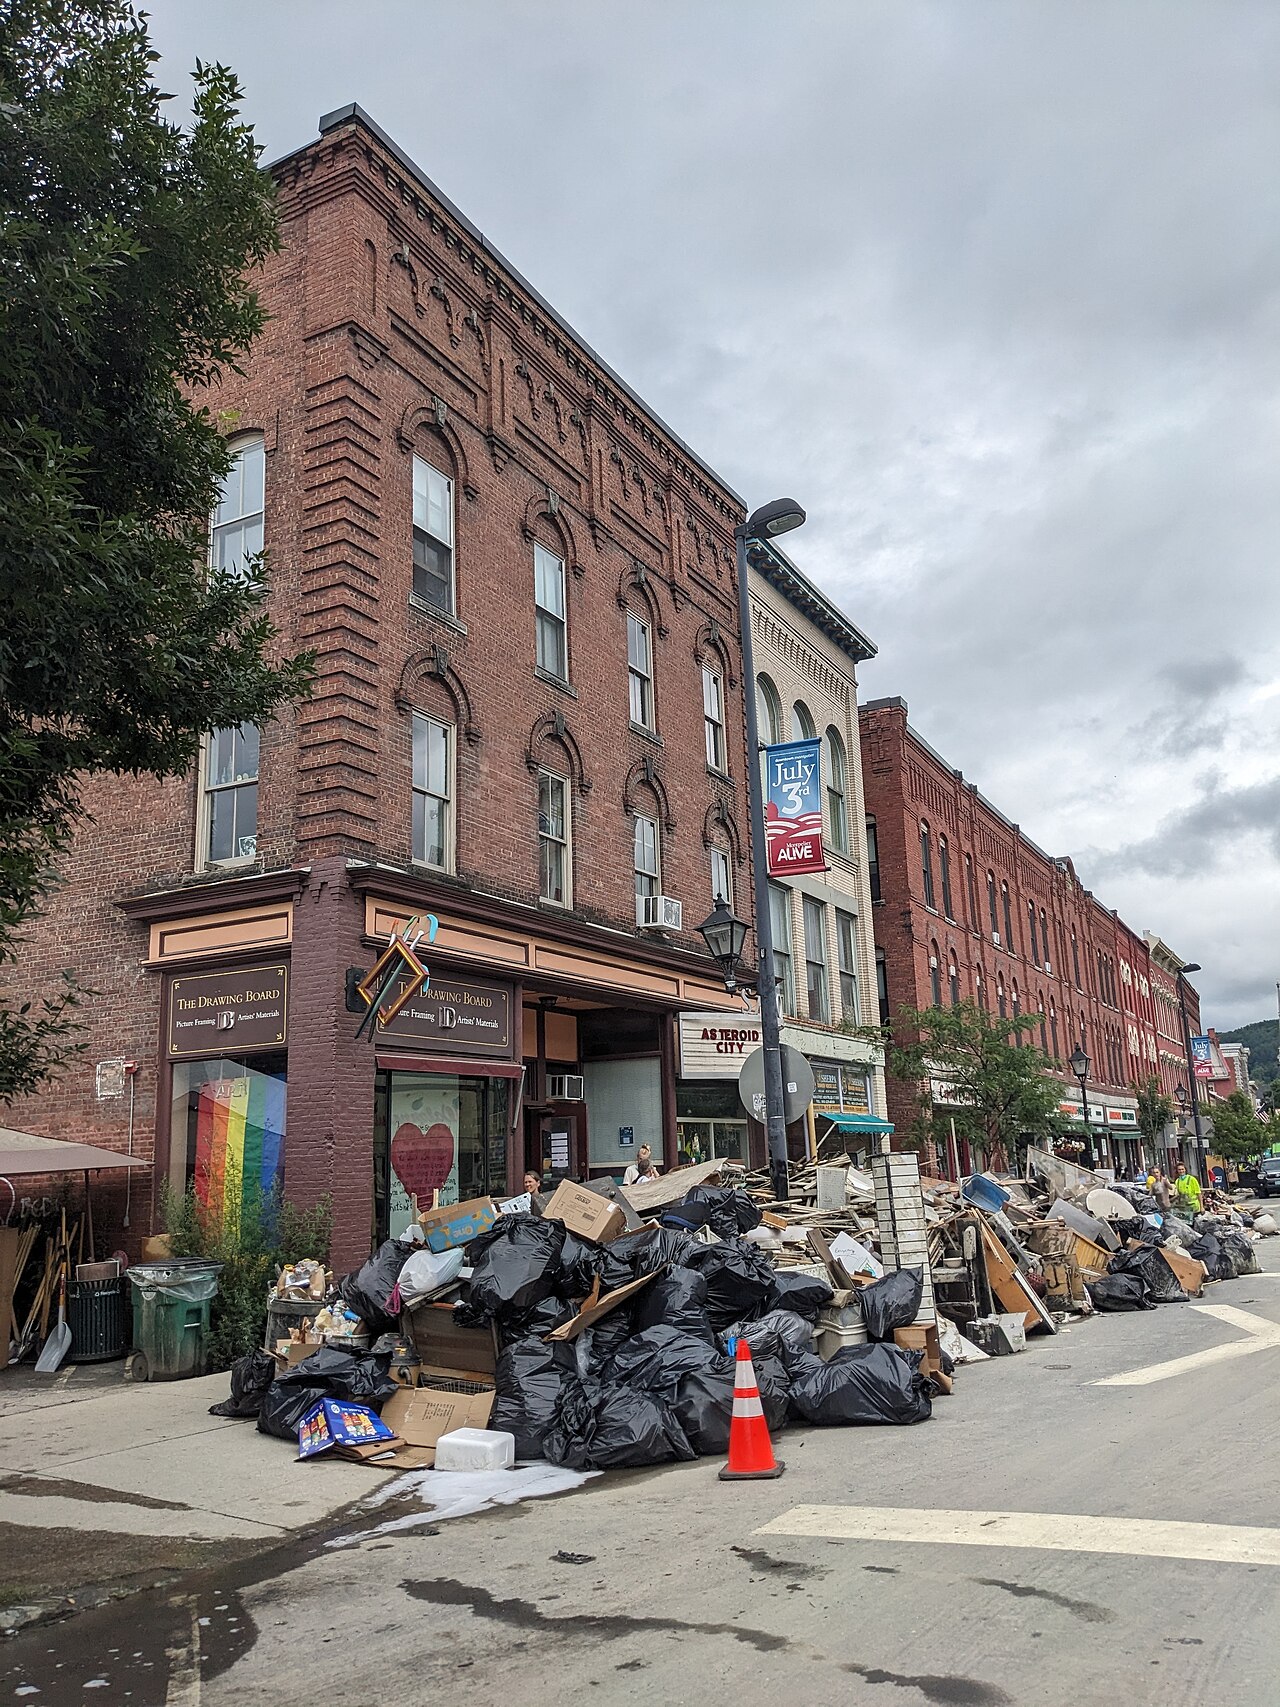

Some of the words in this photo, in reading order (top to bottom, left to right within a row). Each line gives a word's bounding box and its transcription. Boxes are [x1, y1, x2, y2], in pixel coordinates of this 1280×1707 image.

[772, 760, 816, 787] July
[781, 782, 810, 815] 3rd
[786, 841, 811, 849] Montpelier
[177, 999, 196, 1010] THE
[198, 995, 243, 1007] DRAWING
[246, 989, 280, 1003] BOARD
[420, 984, 461, 1003] DRAWING
[463, 991, 493, 1008] BOARD
[255, 1009, 280, 1019] Materials
[411, 1008, 435, 1022] Framing
[176, 1020, 193, 1028] Picture
[194, 1018, 216, 1026] Framing
[475, 1017, 499, 1029] Materials
[701, 1028, 760, 1041] ASTEROID
[716, 1042, 745, 1054] CITY
